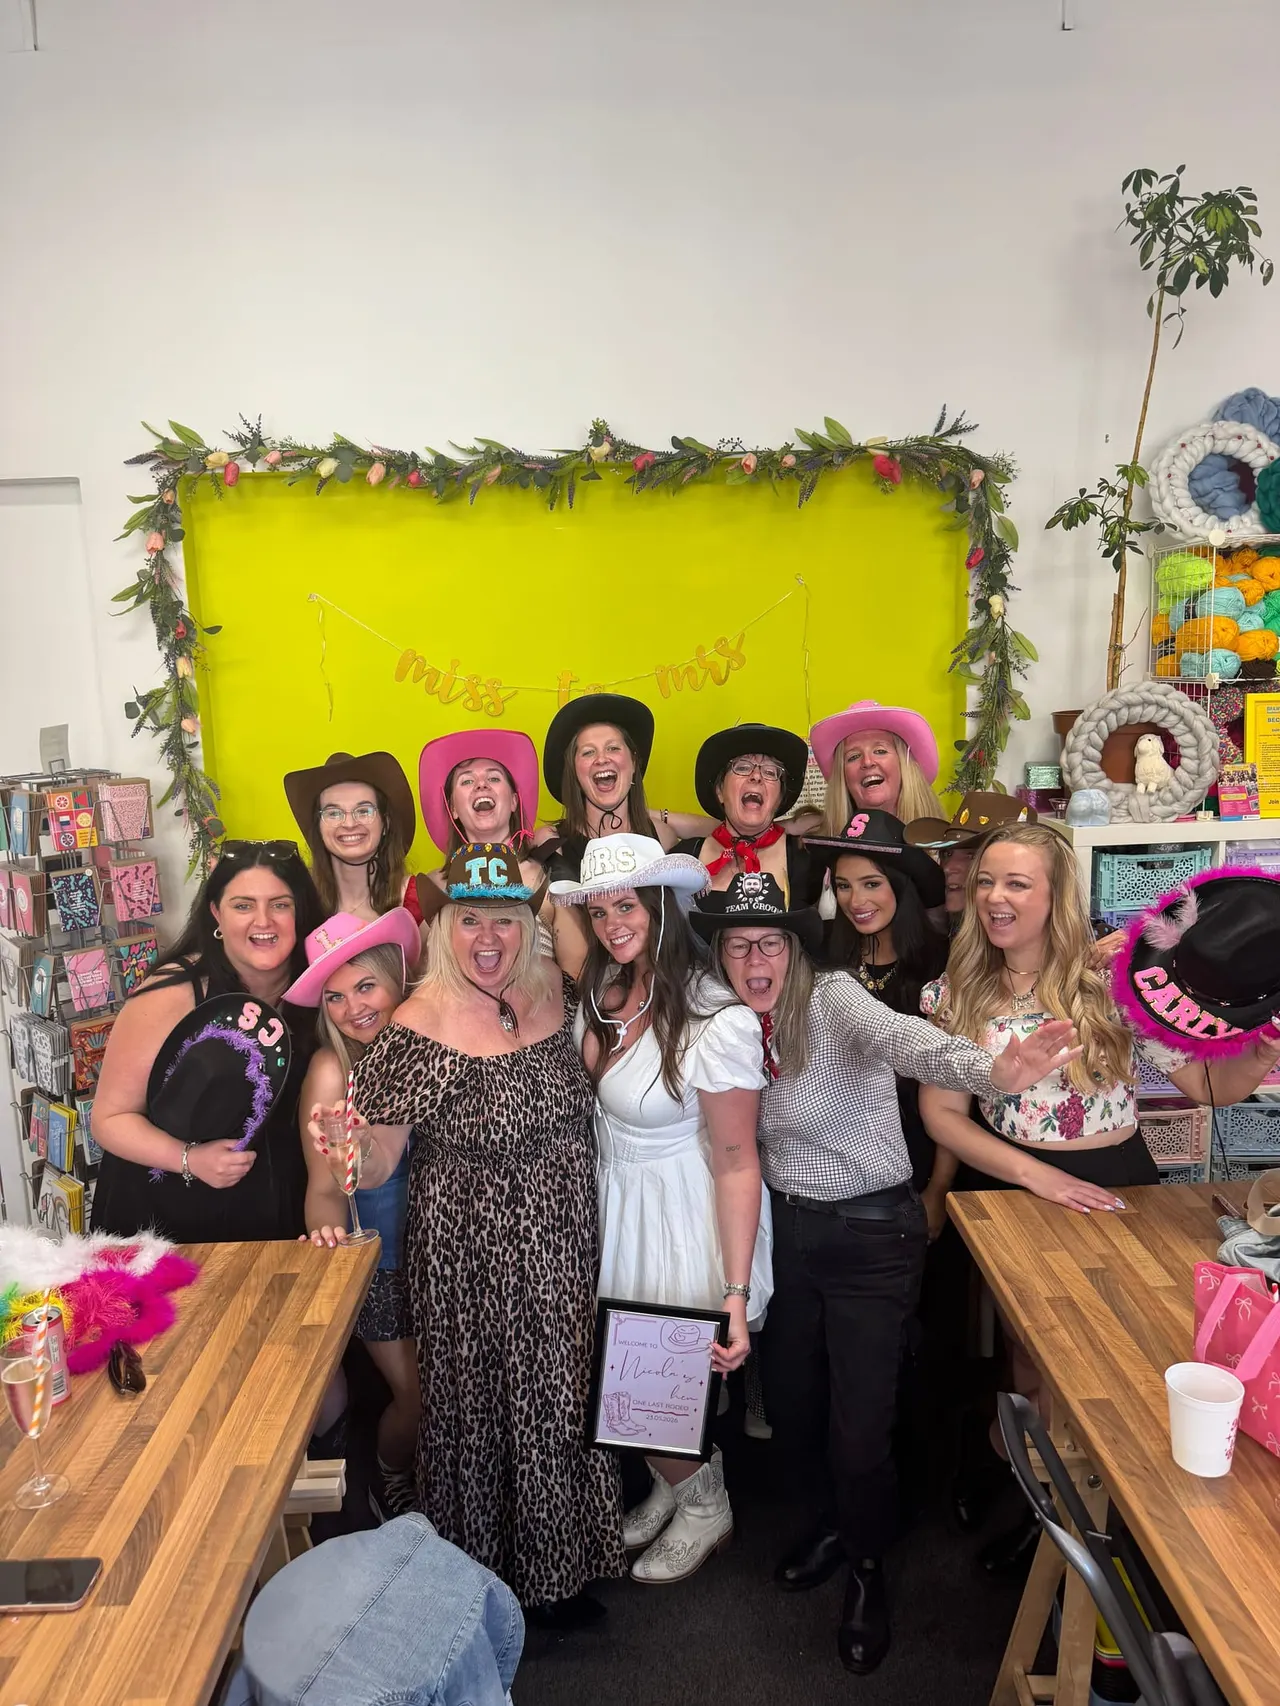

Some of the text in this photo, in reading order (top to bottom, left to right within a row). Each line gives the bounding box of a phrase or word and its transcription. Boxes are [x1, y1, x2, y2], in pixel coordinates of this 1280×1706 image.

[394, 632, 746, 717] miss t mrs
[846, 813, 870, 838] S
[465, 856, 509, 885] TC
[725, 902, 749, 913] TEAM
[1133, 965, 1245, 1040] CARLY
[237, 1001, 284, 1047] SJ
[618, 1339, 648, 1349] WELCOME
[665, 1403, 689, 1411] RODEO
